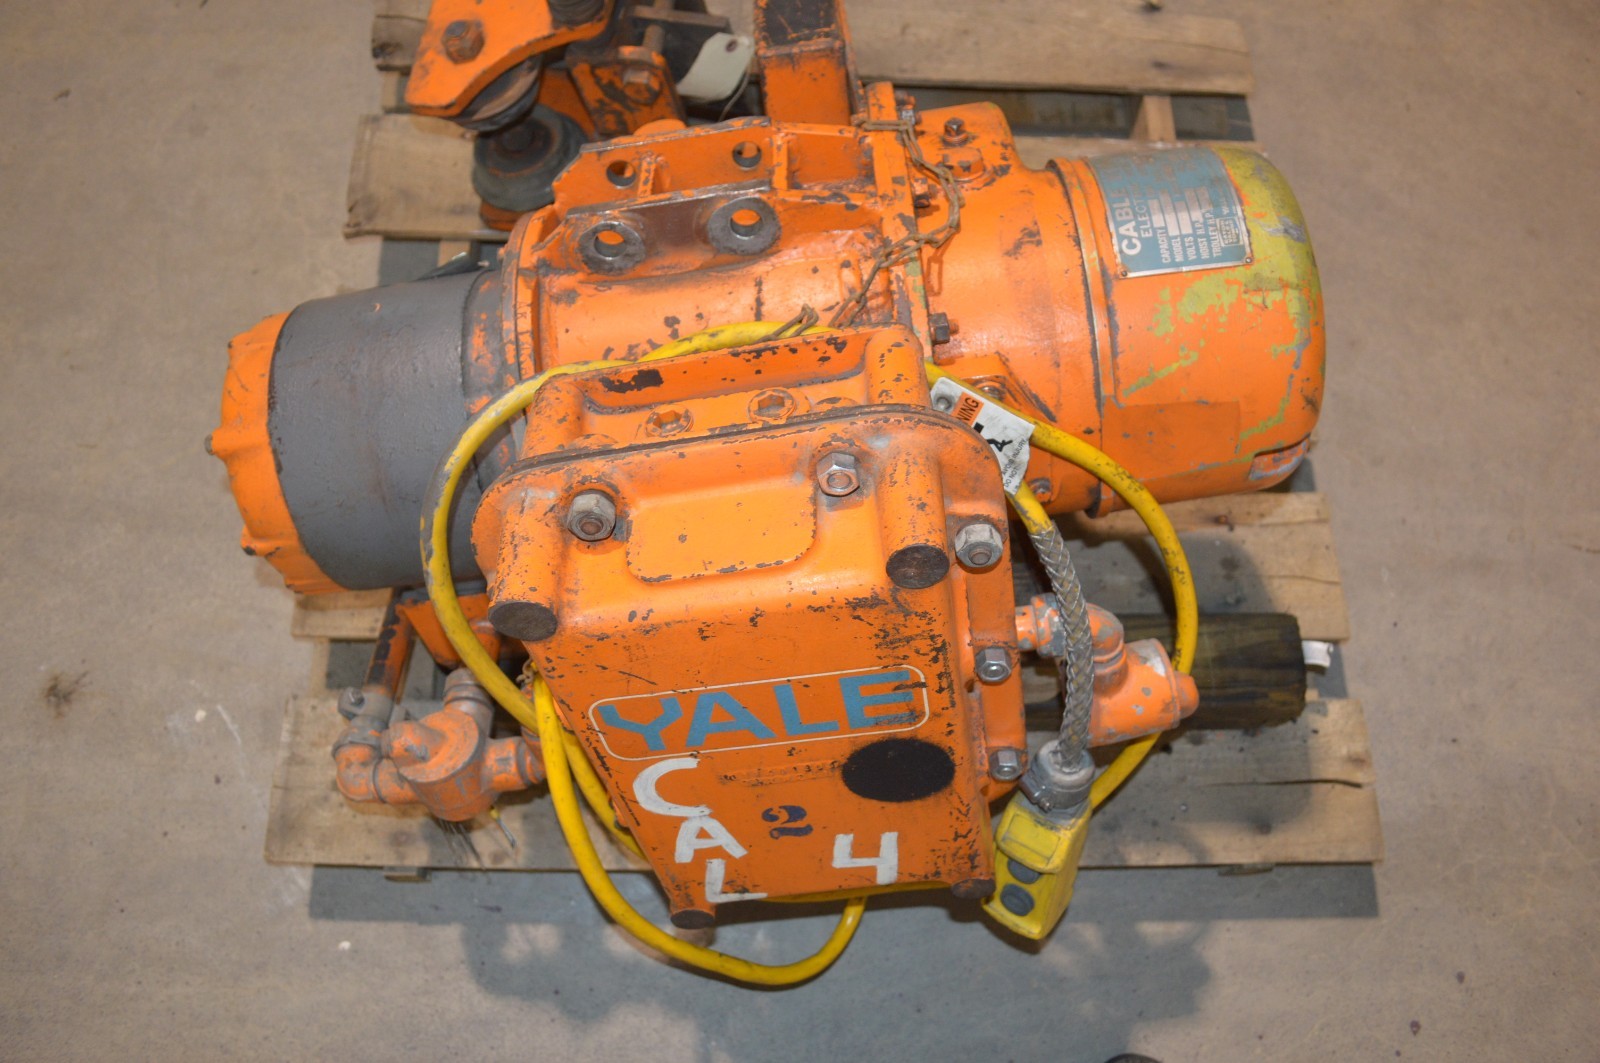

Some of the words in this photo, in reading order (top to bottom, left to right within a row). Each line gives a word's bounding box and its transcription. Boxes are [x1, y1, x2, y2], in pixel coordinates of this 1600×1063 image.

[1156, 227, 1171, 264] CAPACITY
[1171, 236, 1184, 262] MODEL
[1184, 237, 1197, 260] VOLTS
[1197, 237, 1210, 259] HOIST
[1207, 227, 1222, 257] TROLLEY
[956, 397, 979, 421] NING
[599, 670, 916, 751] YALE
[832, 831, 898, 885] 4
